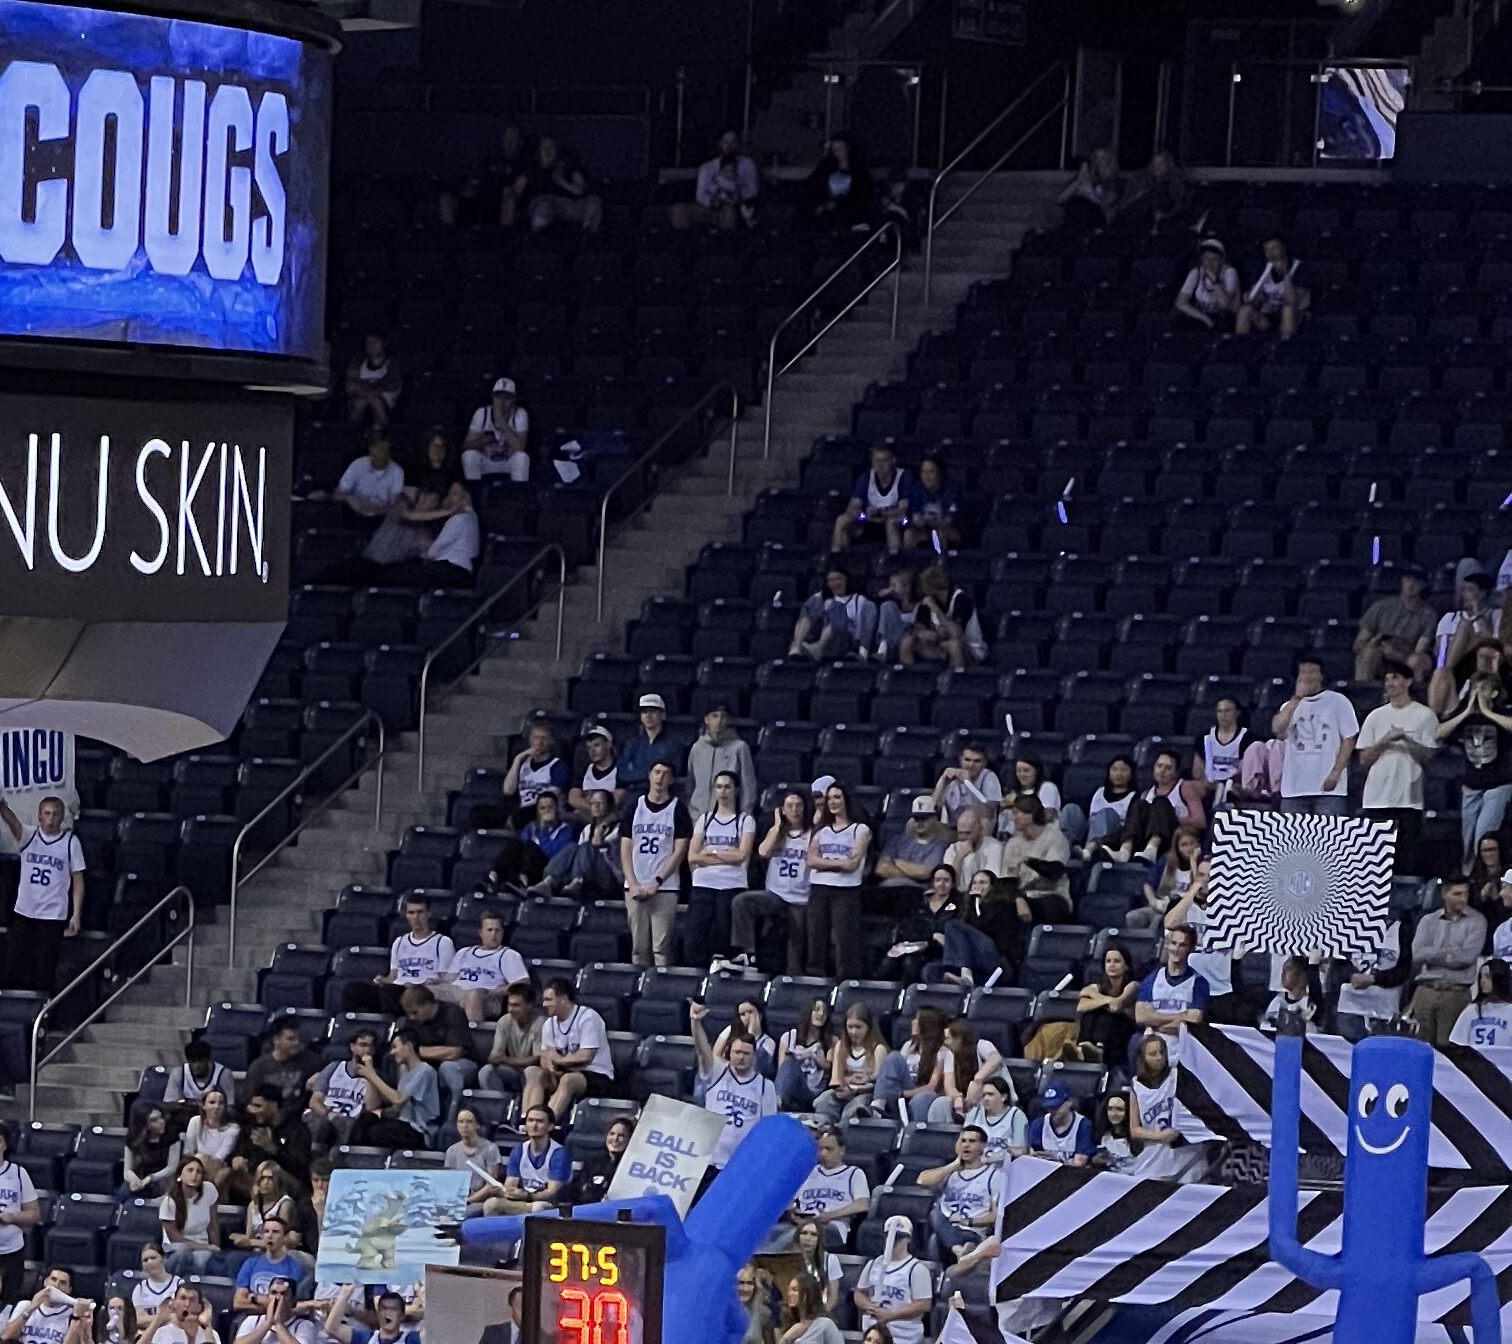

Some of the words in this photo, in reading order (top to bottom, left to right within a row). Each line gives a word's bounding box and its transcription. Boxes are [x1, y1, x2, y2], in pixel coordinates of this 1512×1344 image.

[129, 438, 266, 578] SKIN
[639, 836, 659, 854] 26
[30, 867, 52, 886] 26
[778, 860, 800, 878] 26
[1475, 1026, 1496, 1046] 54
[645, 1128, 700, 1160] BALL
[654, 1150, 679, 1169] IS
[628, 1161, 690, 1194] BACK
[548, 1242, 619, 1287] 37.5
